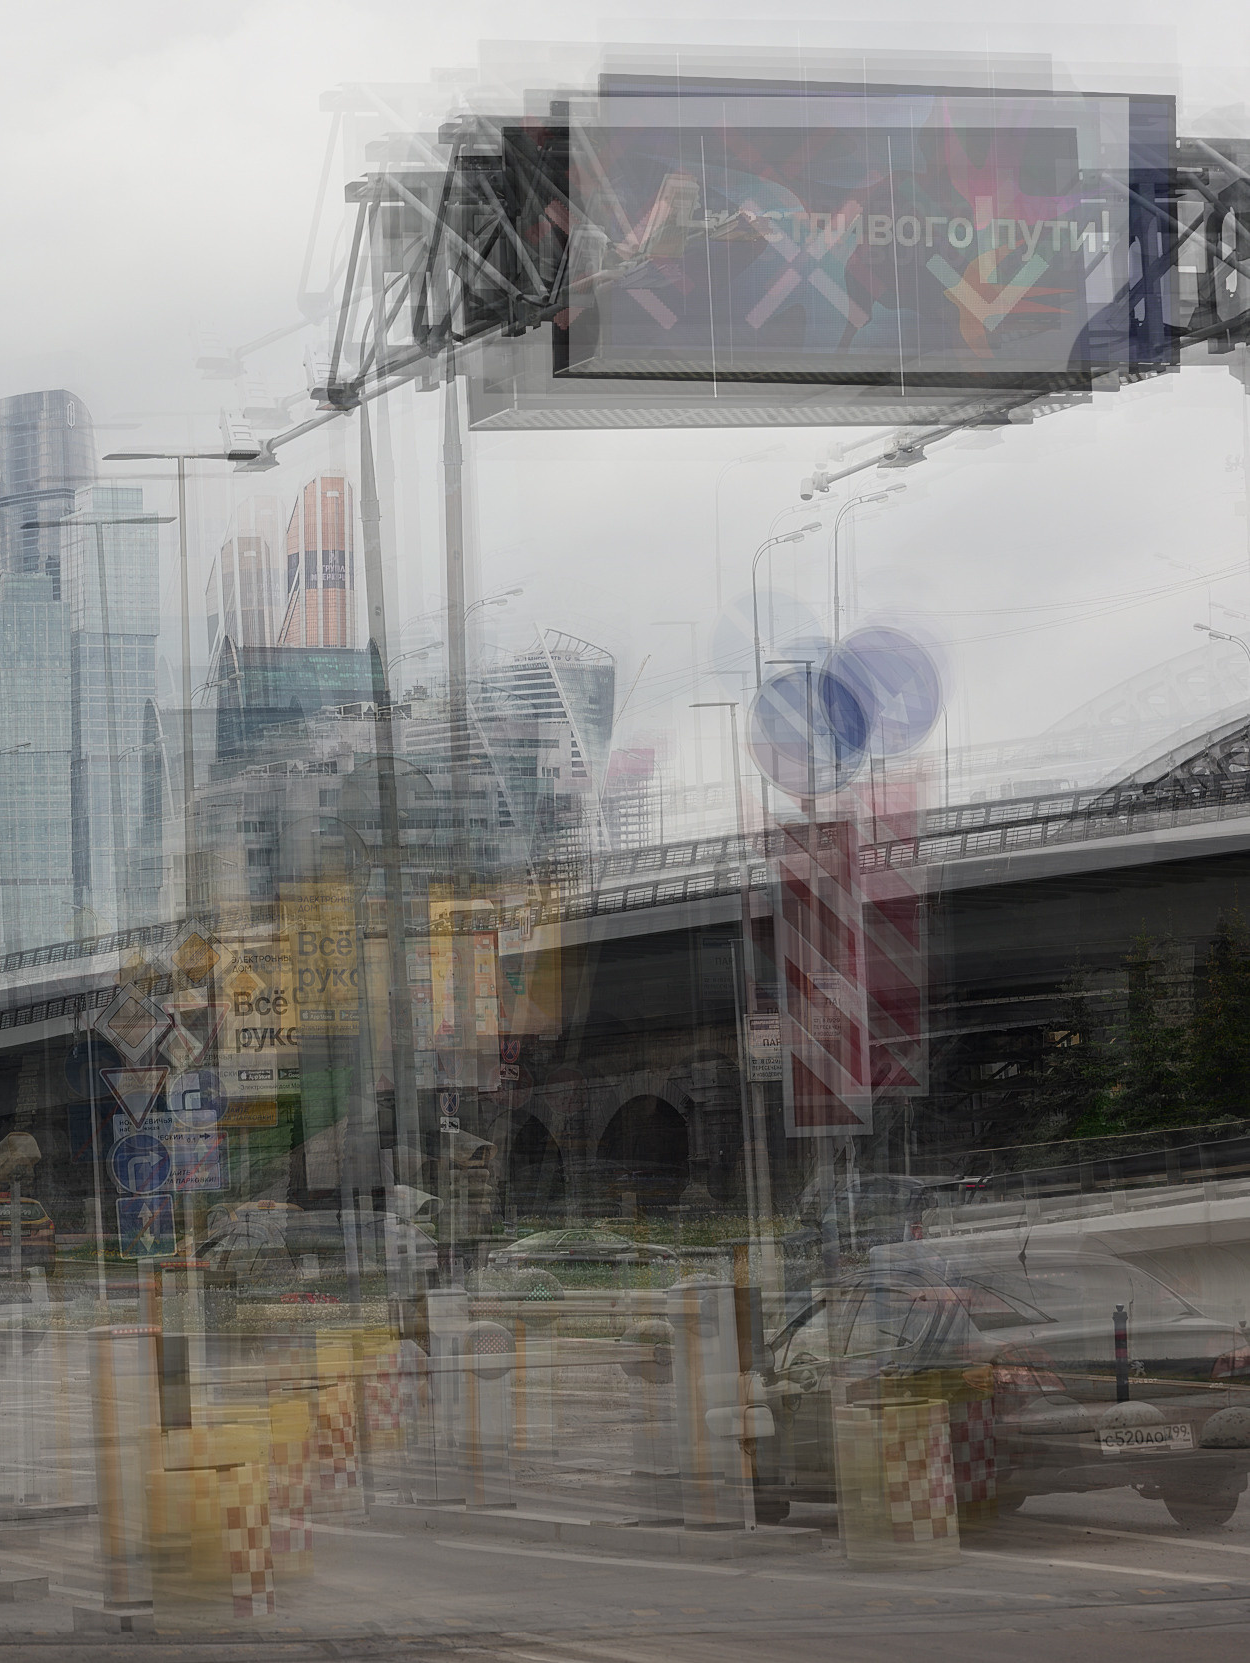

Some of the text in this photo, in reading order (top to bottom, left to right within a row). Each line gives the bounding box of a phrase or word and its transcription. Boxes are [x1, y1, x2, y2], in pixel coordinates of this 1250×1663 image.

[991, 210, 1111, 262] пути!
[298, 930, 352, 957] Всё
[234, 989, 288, 1016] Всё
